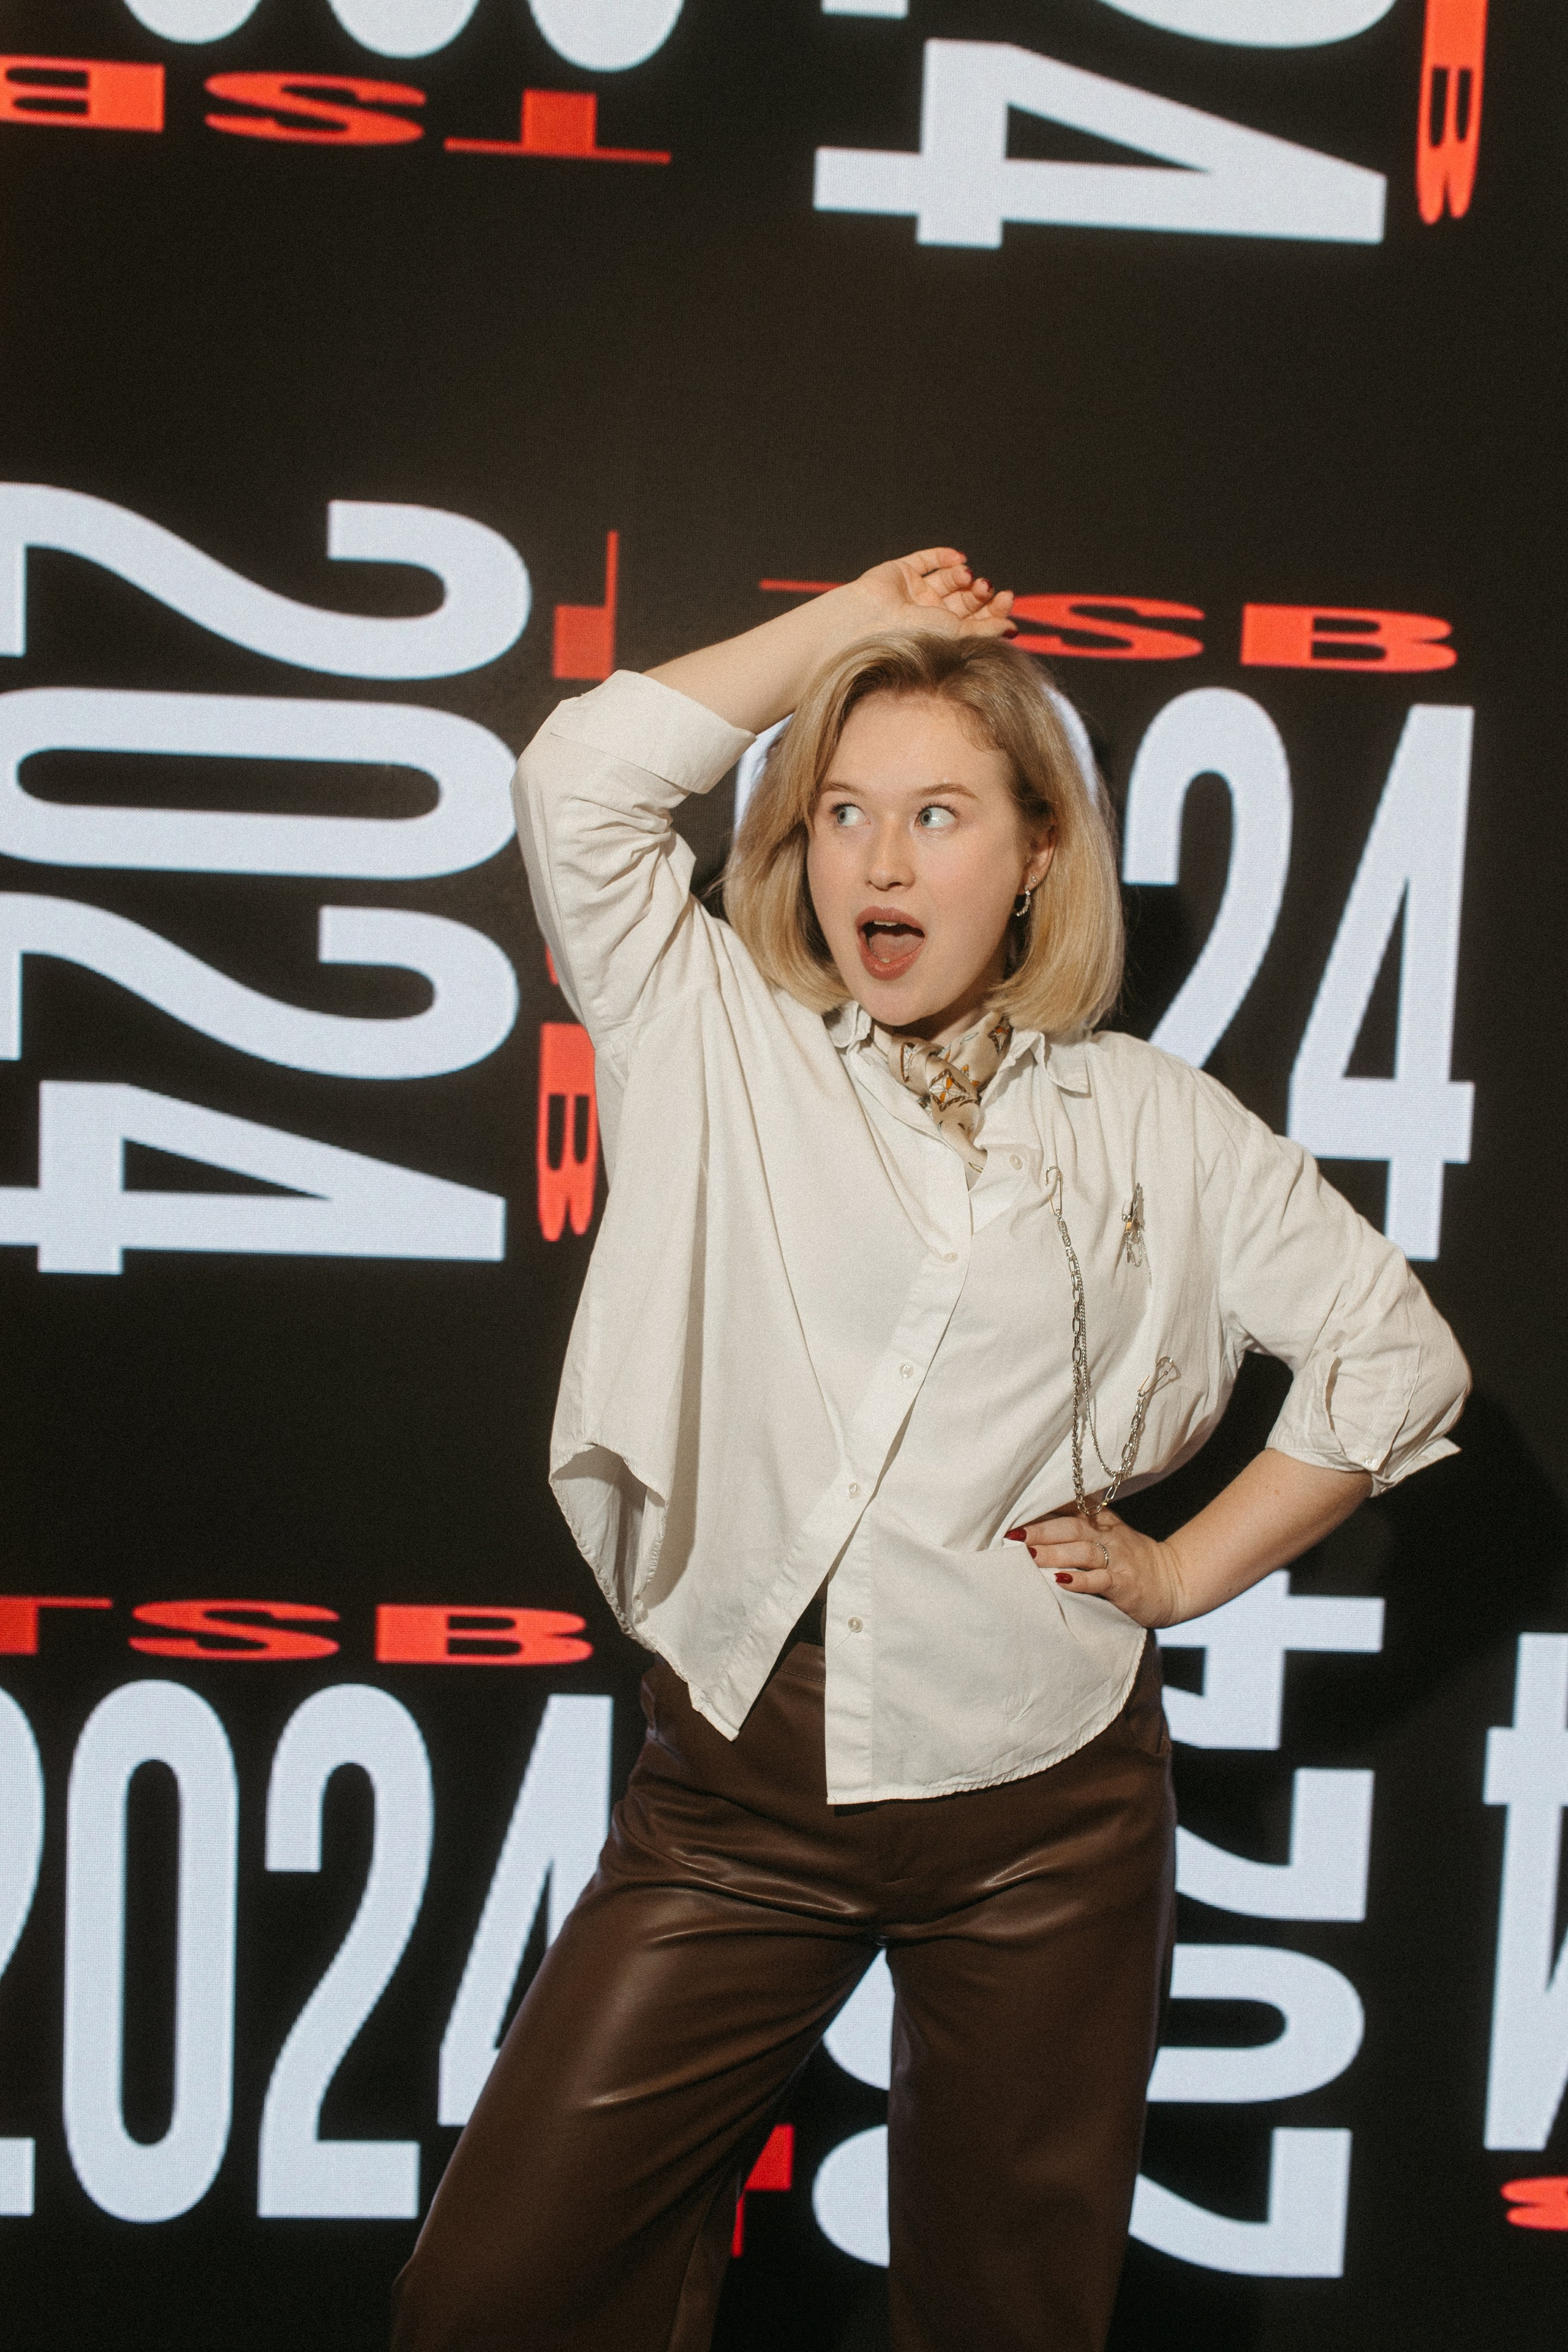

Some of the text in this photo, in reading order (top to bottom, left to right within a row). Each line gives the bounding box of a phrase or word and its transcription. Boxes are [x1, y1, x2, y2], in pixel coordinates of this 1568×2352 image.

[0, 482, 532, 1276] 2024
[536, 530, 619, 1242] TB
[759, 578, 1458, 673] SB
[734, 687, 1475, 1262] 24
[0, 1679, 614, 2223] 024
